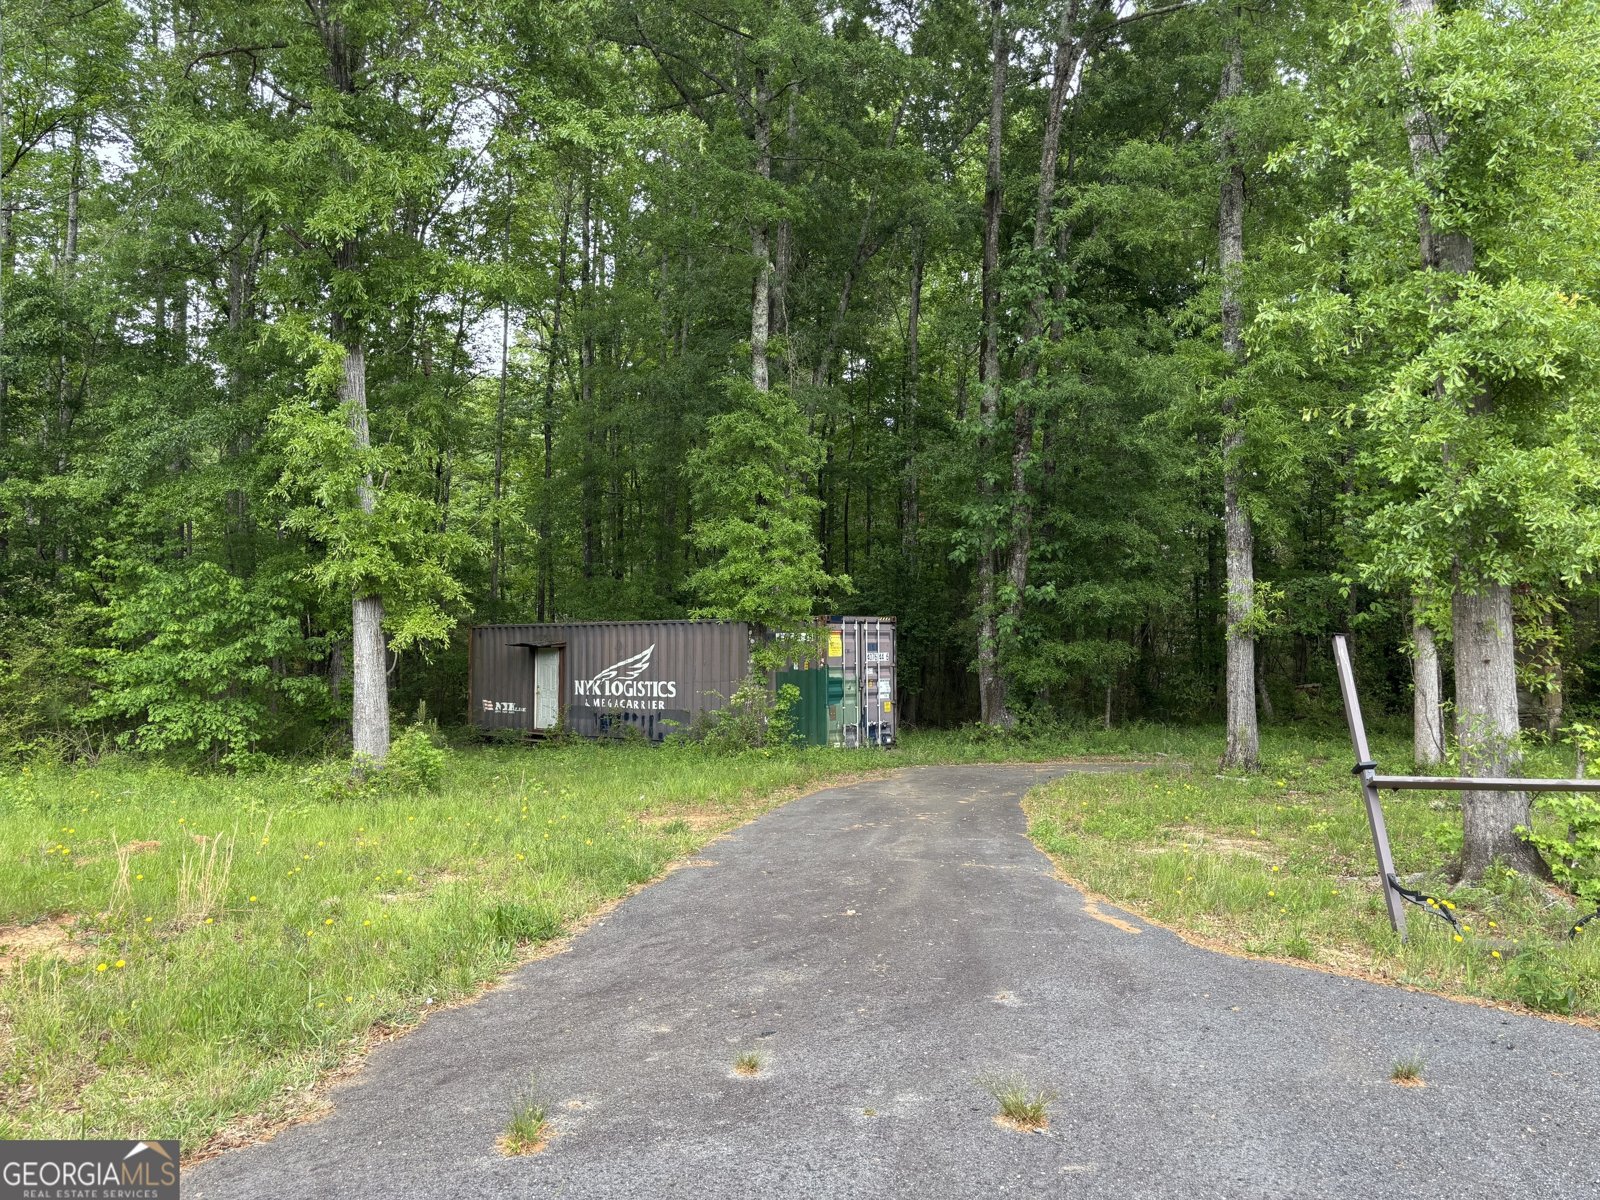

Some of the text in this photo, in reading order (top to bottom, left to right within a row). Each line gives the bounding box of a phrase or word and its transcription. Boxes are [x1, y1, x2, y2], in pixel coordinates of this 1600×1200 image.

[574, 680, 677, 697] NYK LOGISTICS
[593, 698, 665, 710] MEGACARRIER
